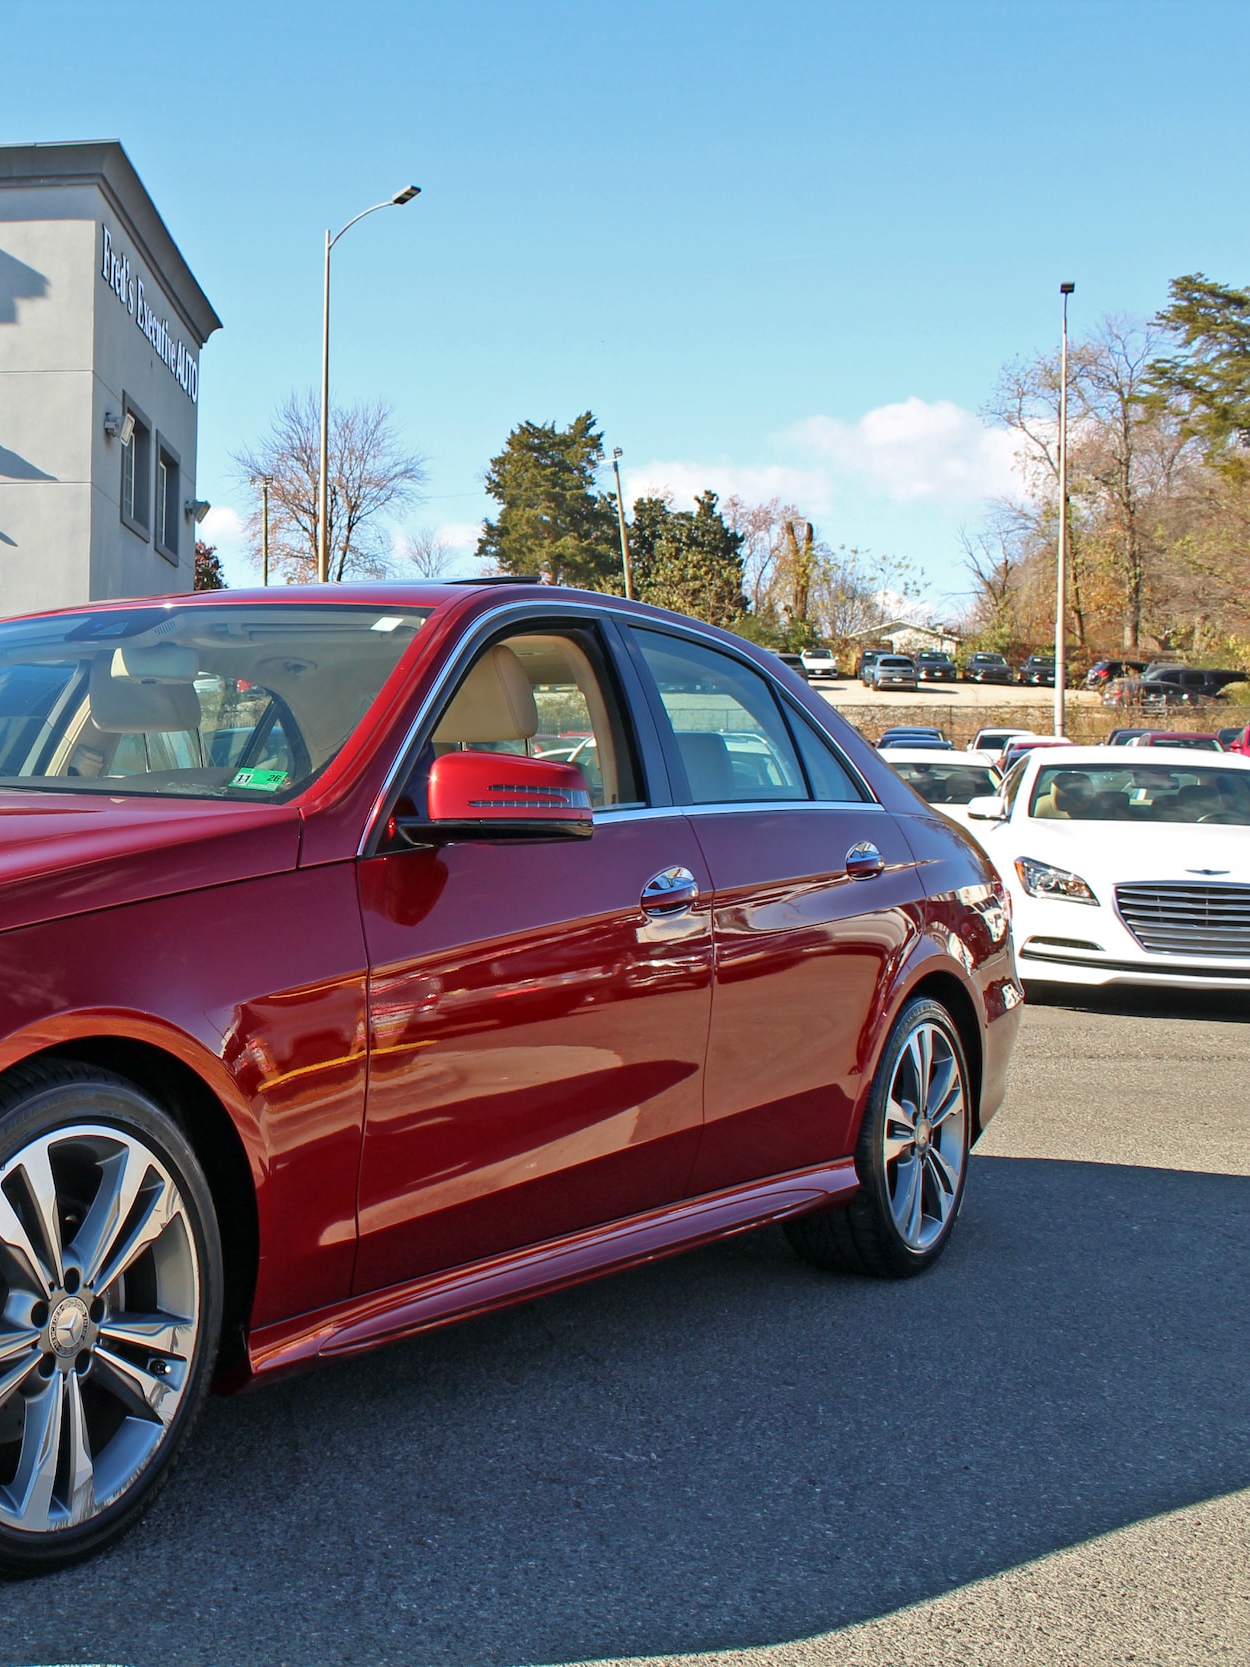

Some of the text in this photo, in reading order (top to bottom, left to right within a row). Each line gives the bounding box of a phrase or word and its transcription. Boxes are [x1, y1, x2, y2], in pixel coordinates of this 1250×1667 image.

[101, 223, 198, 404] Fred's Executive AUTO
[236, 774, 252, 783] 11
